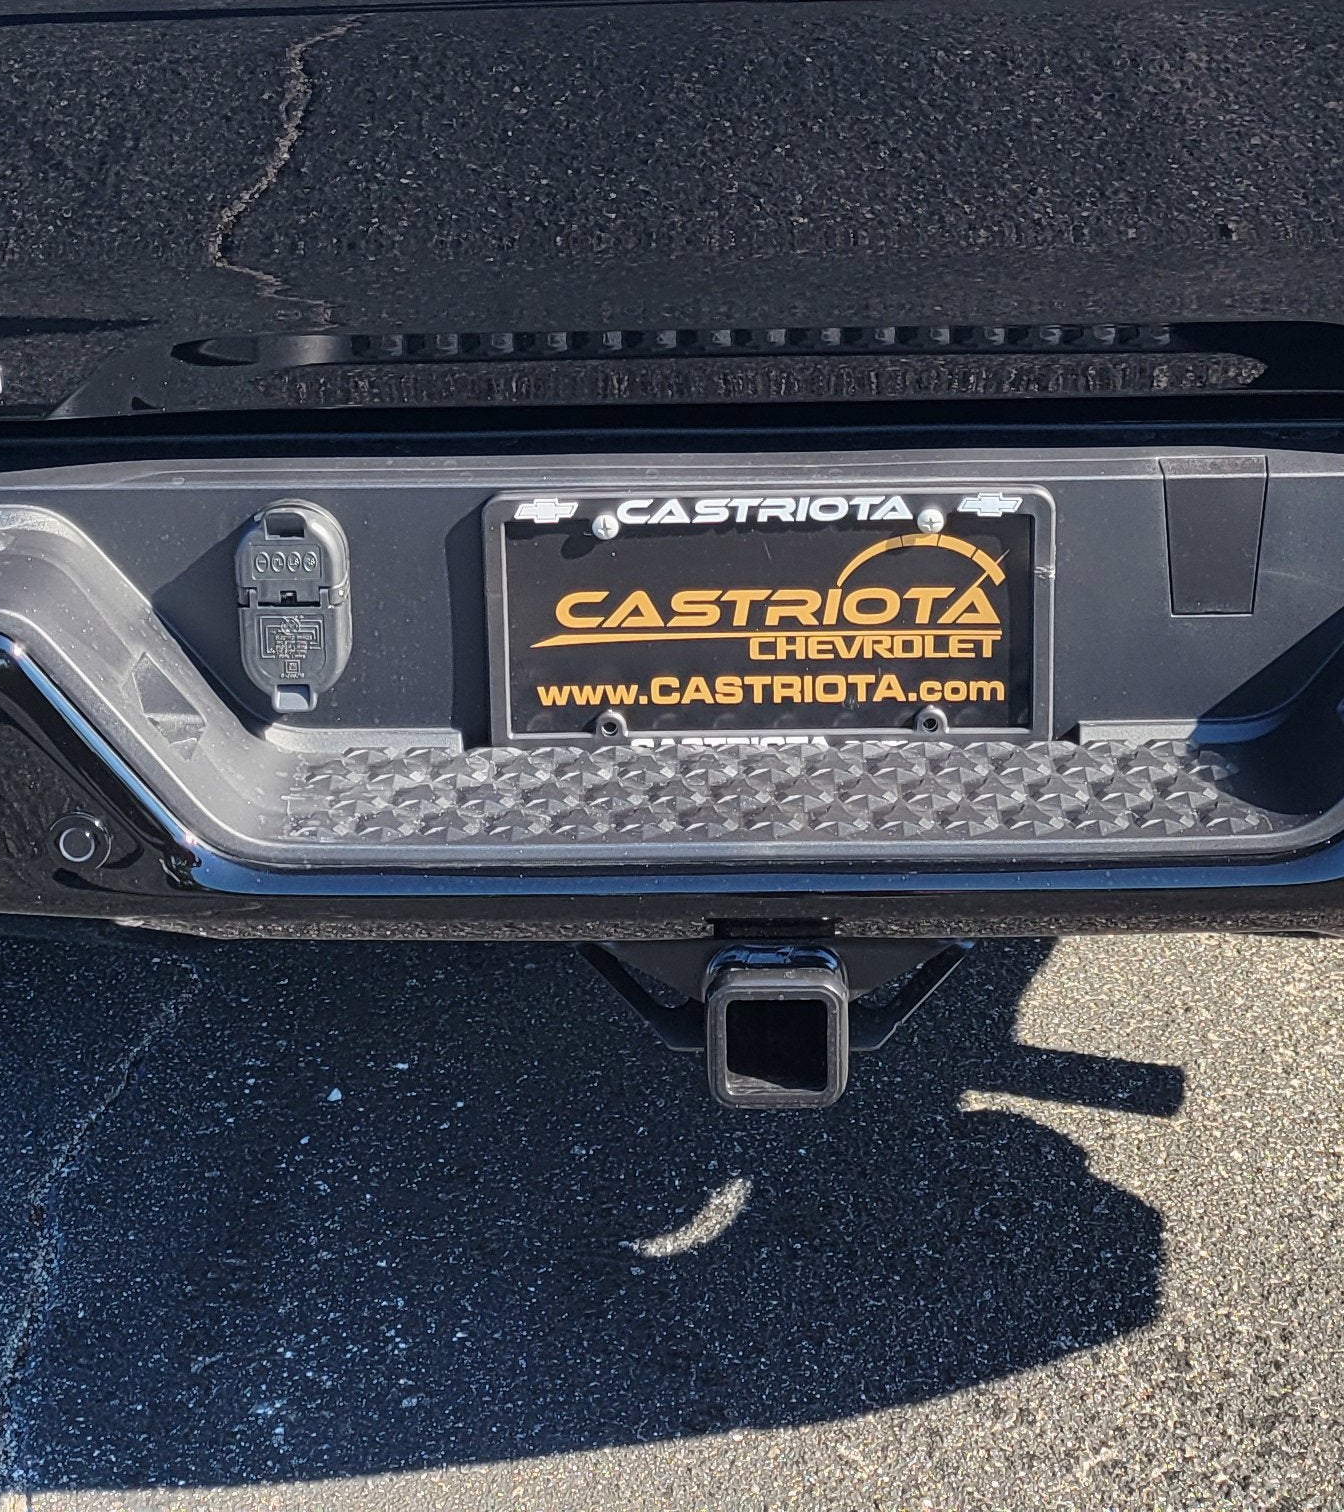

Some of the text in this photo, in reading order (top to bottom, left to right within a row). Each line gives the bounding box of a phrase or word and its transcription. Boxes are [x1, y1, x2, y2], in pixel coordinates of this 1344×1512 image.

[616, 495, 914, 525] CASTRIOTA
[555, 586, 1001, 630] CASTRIOTA
[748, 635, 1001, 661] CHEVROLET
[536, 674, 1006, 706] www.CASTRIOTA.com
